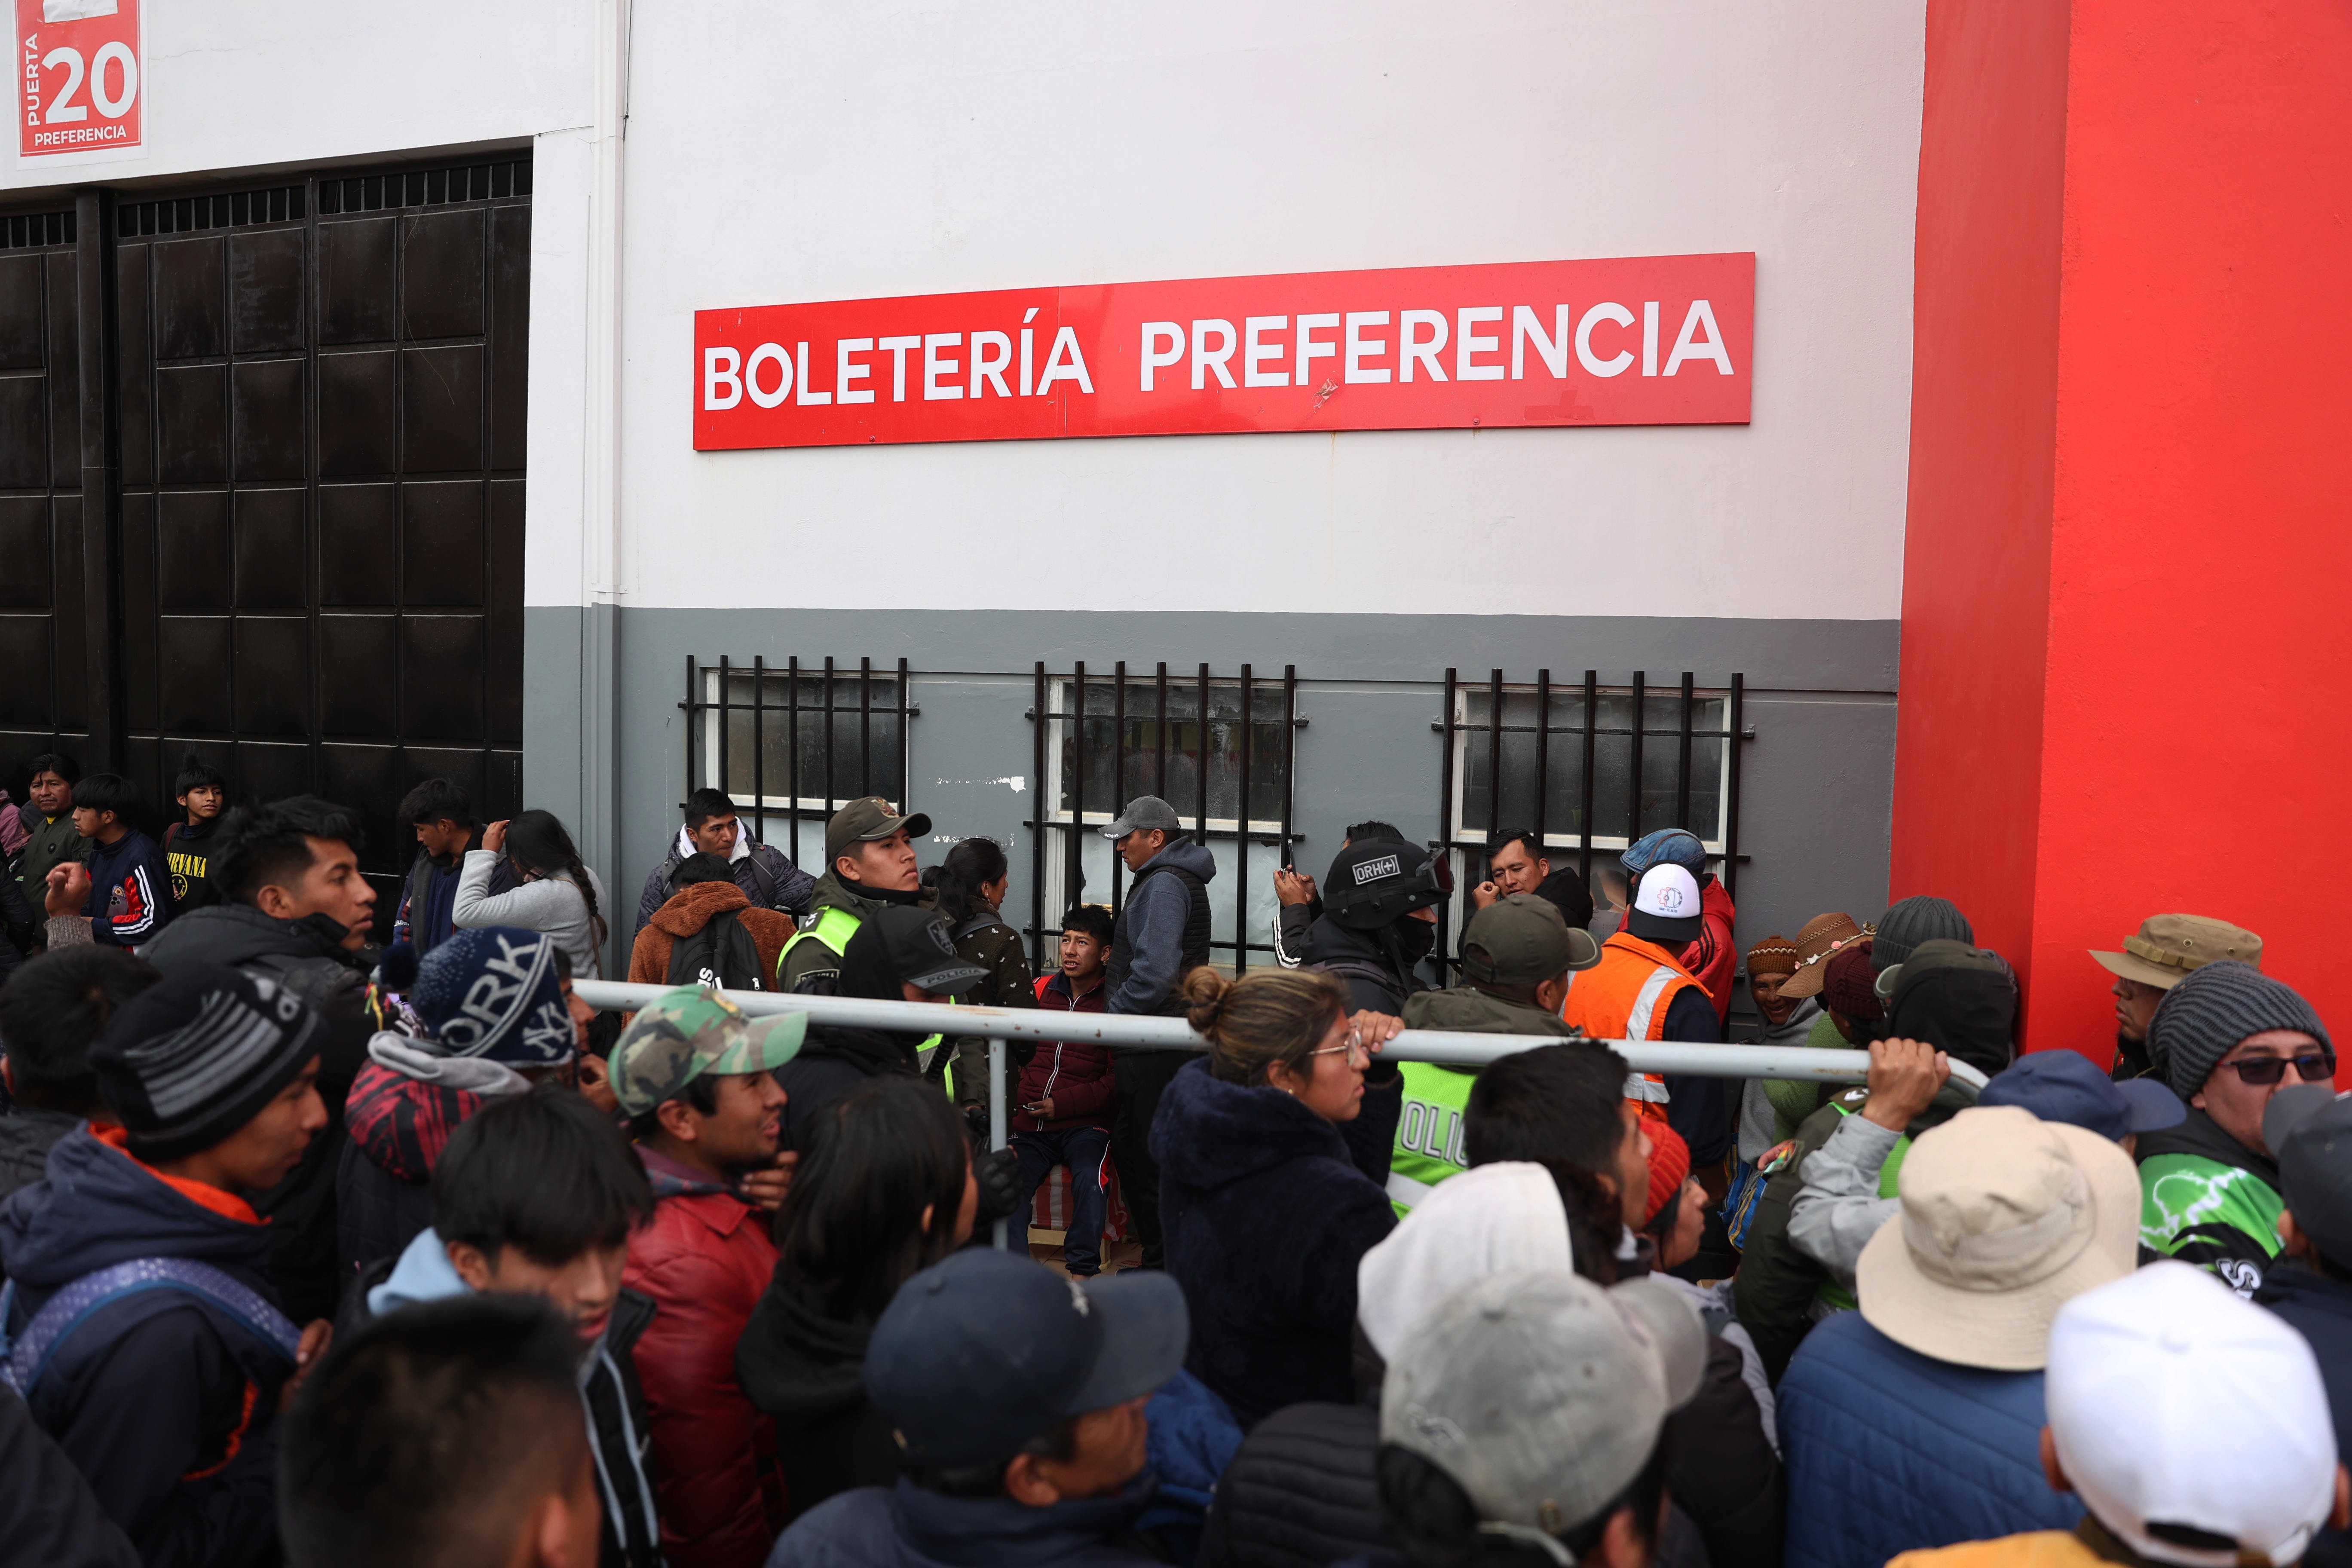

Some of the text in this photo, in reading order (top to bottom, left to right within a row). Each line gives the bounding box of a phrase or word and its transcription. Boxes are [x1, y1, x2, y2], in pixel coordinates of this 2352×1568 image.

[25, 33, 40, 126] PUERTA
[42, 41, 138, 124] 20
[35, 125, 127, 146] PREFERENCIA
[704, 293, 1734, 410] BOLETERÍA PREFERENCIA
[1356, 858, 1396, 880] ORH(+)
